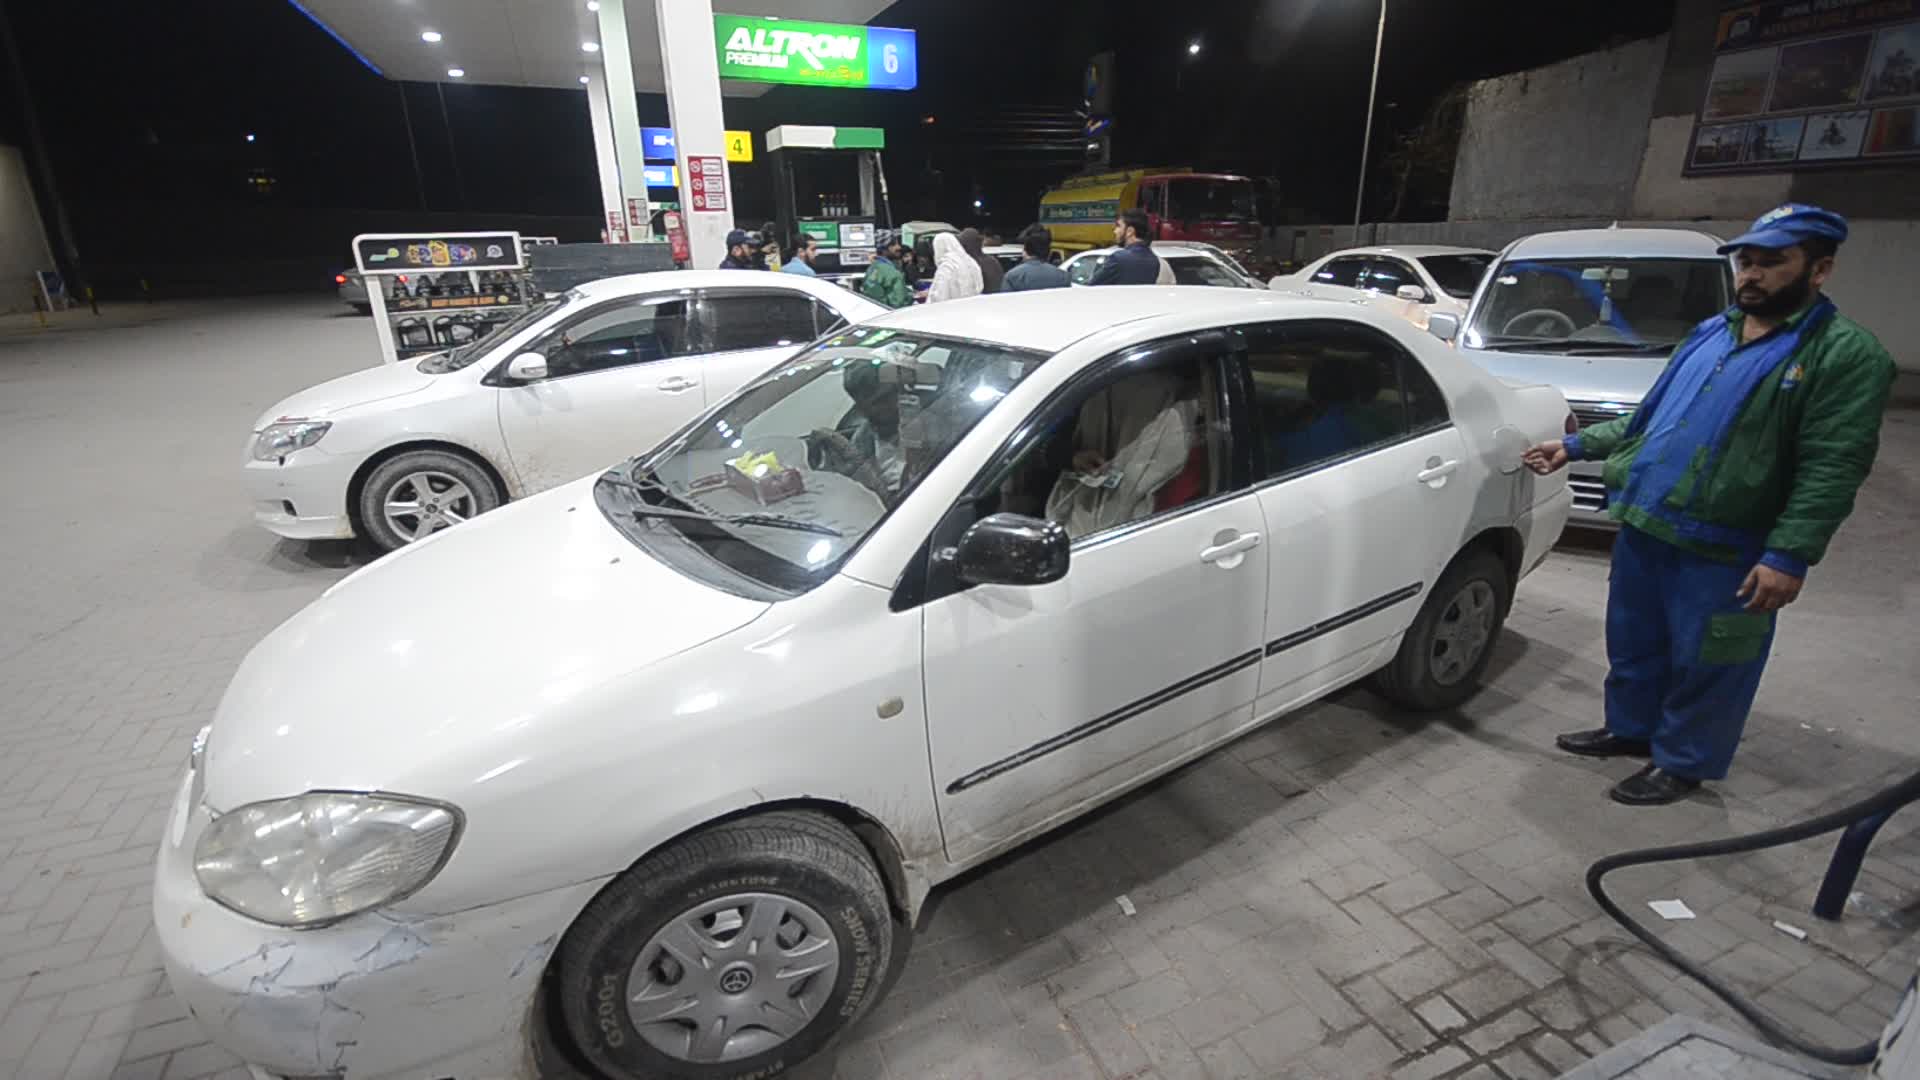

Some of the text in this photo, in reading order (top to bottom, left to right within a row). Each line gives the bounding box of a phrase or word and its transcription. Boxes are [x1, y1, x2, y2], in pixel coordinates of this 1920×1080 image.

[726, 27, 860, 70] ALTRON
[726, 52, 788, 68] PREMIUM
[883, 43, 899, 74] 6
[733, 138, 743, 154] 4
